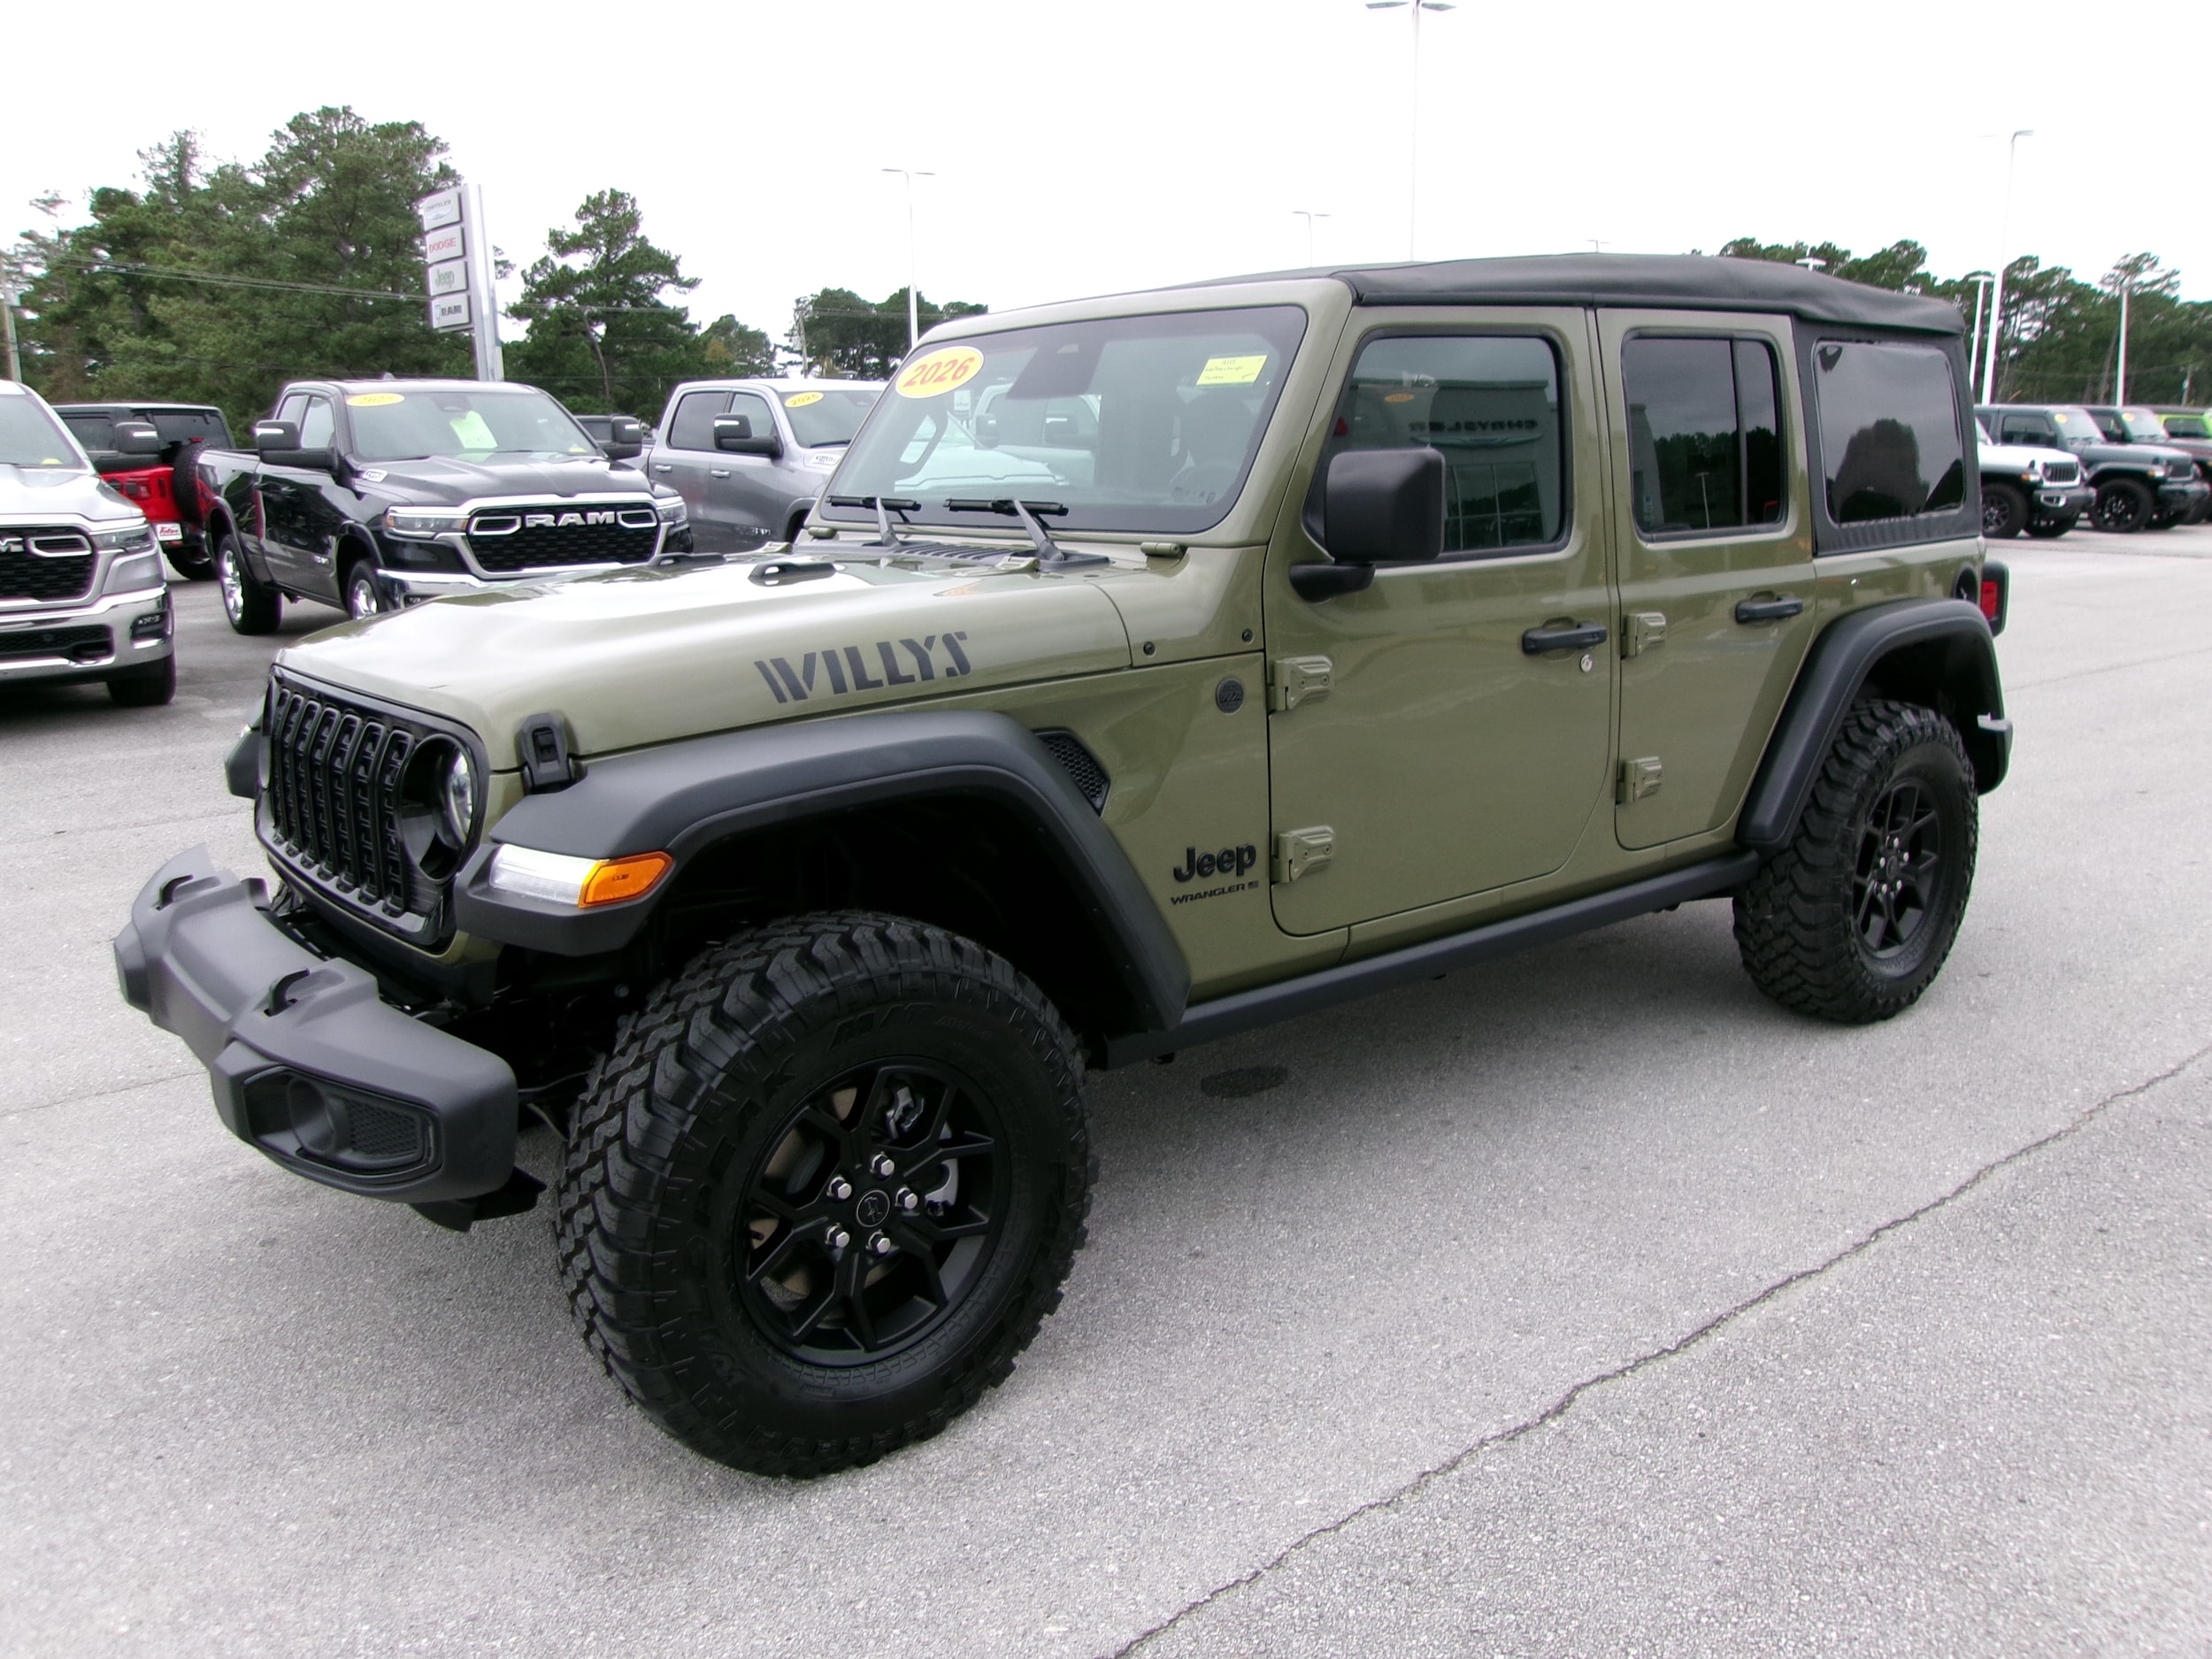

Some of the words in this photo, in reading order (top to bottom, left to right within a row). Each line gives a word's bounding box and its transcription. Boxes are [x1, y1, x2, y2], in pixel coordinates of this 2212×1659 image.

[428, 236, 457, 253] DODGE
[434, 268, 455, 288] Jeep
[441, 304, 463, 316] RAM
[902, 357, 975, 388] 2026
[526, 511, 616, 527] RAM
[754, 631, 972, 703] WILLYS
[1173, 843, 1256, 883] Jeep
[1170, 883, 1246, 905] WRANGLER
